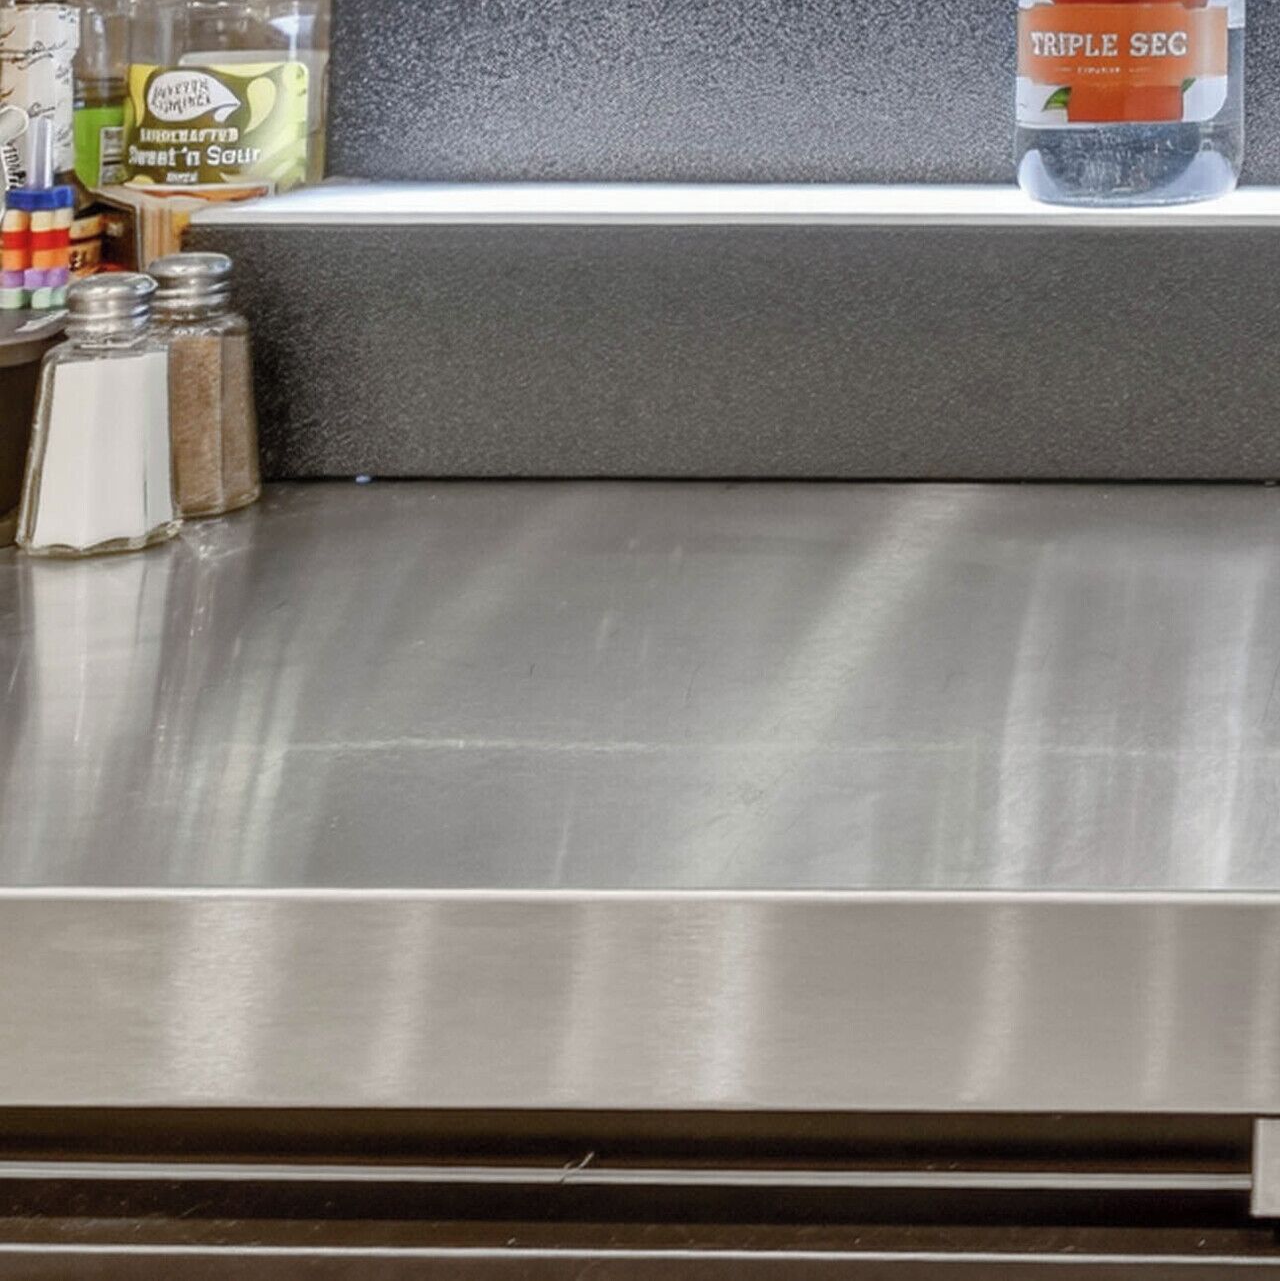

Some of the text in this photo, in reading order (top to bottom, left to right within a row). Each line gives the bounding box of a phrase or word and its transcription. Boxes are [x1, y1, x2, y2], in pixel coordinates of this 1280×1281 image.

[1030, 31, 1188, 57] TRIPLE SEC
[206, 145, 261, 165] Sour
